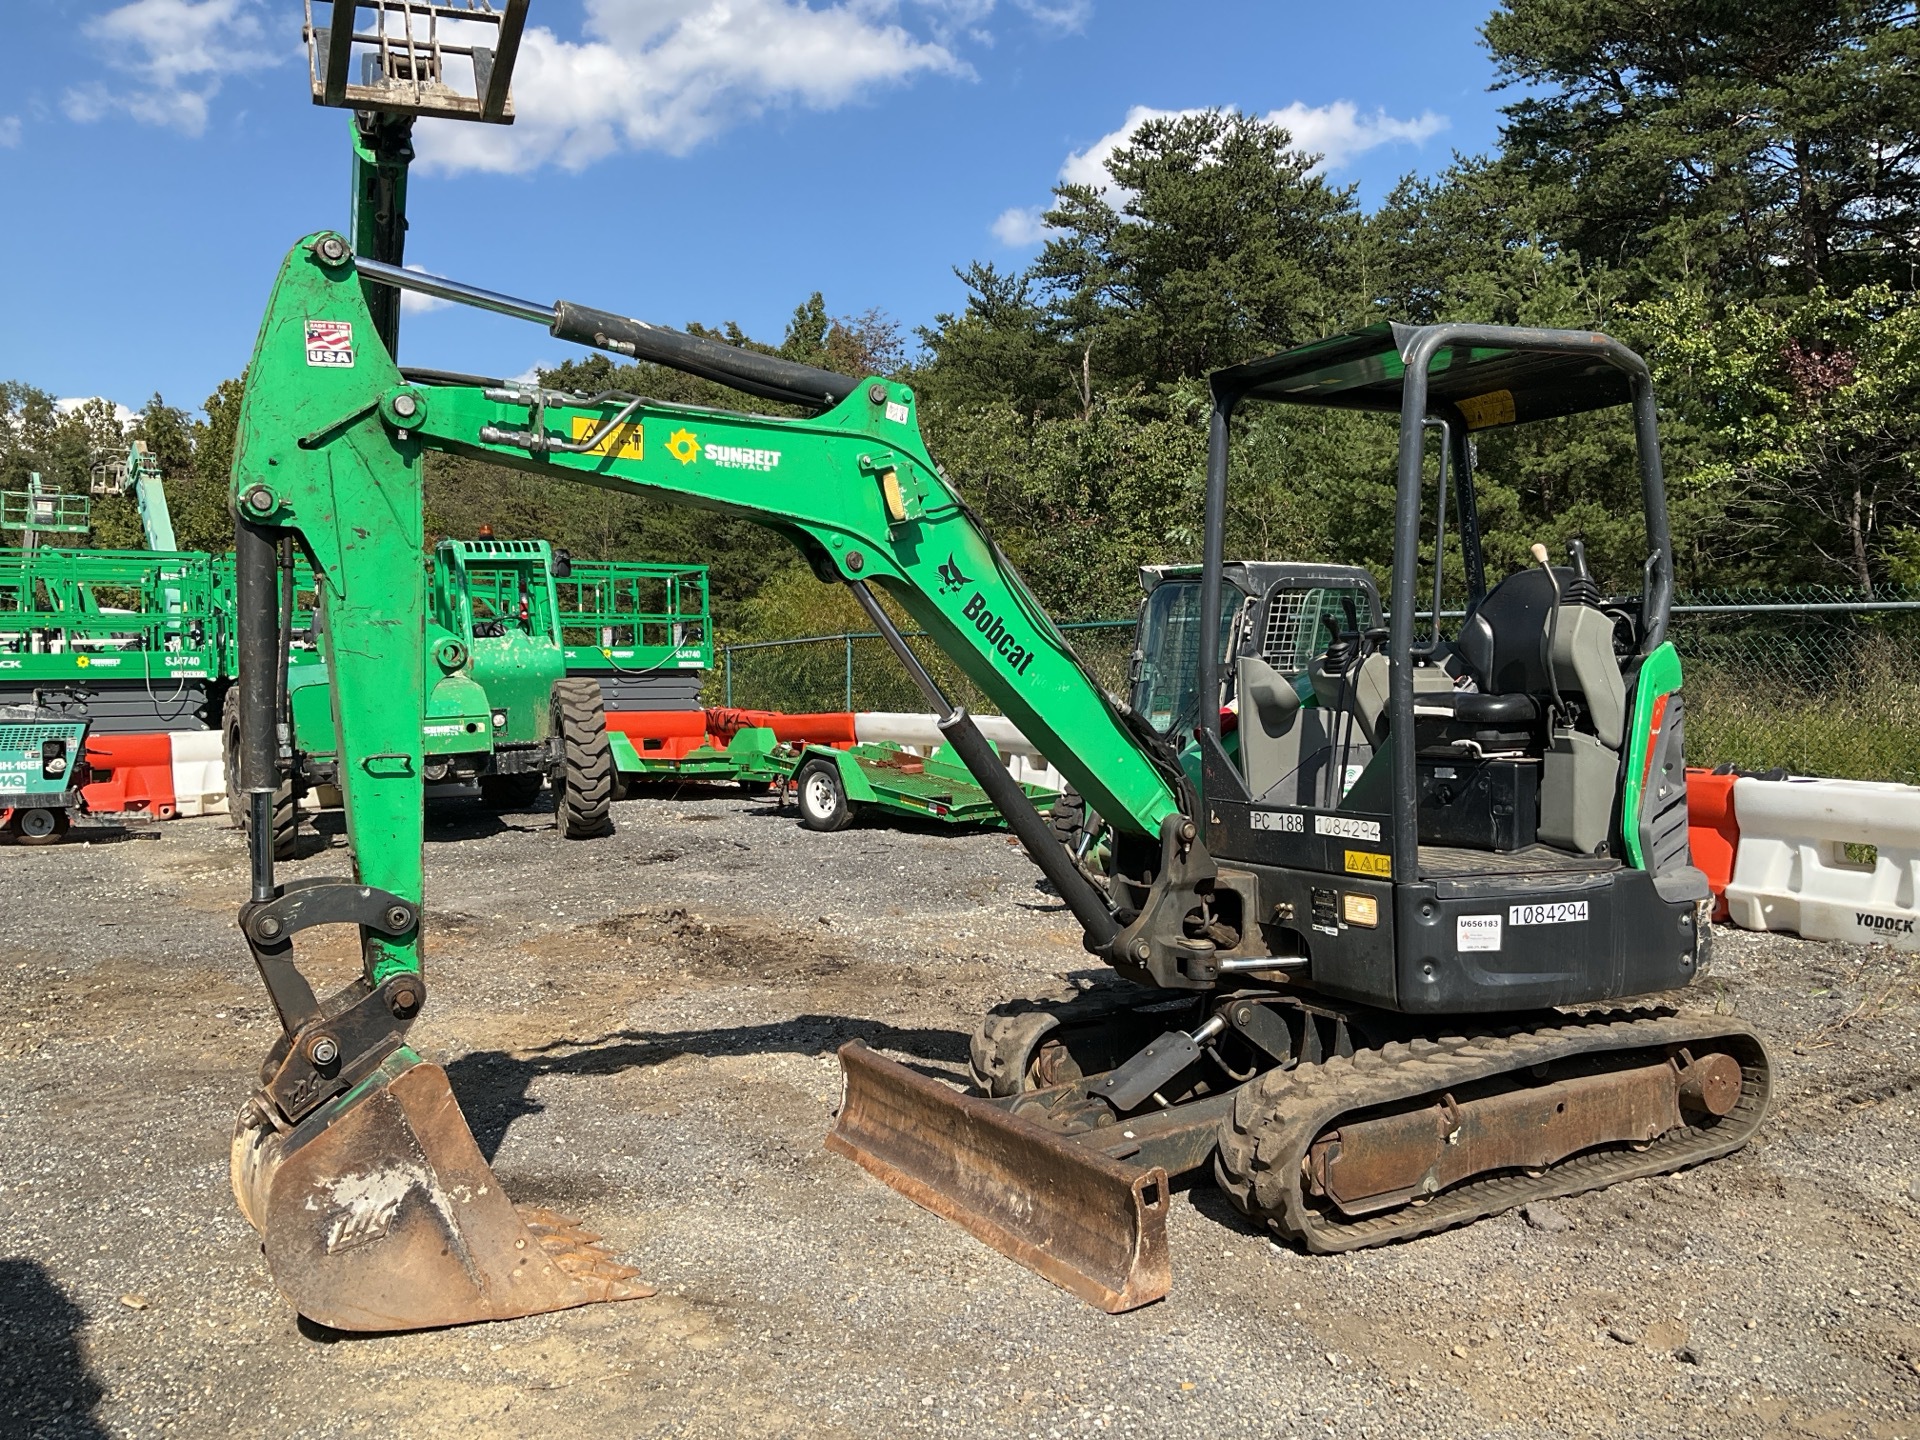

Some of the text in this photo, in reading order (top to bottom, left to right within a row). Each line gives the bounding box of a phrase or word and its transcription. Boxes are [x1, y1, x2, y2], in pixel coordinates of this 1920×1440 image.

[309, 350, 350, 363] USA
[704, 443, 781, 467] SUNBELT
[715, 460, 771, 472] RENTALS
[962, 591, 1034, 676] Bobcat
[165, 656, 200, 667] SJ4740
[675, 650, 700, 659] SJ4740
[1254, 812, 1303, 832] PC 188
[1316, 817, 1379, 839] 1084294
[1511, 902, 1587, 925] 1084294
[1856, 912, 1914, 933] YODOCK
[1460, 920, 1498, 928] U656183
